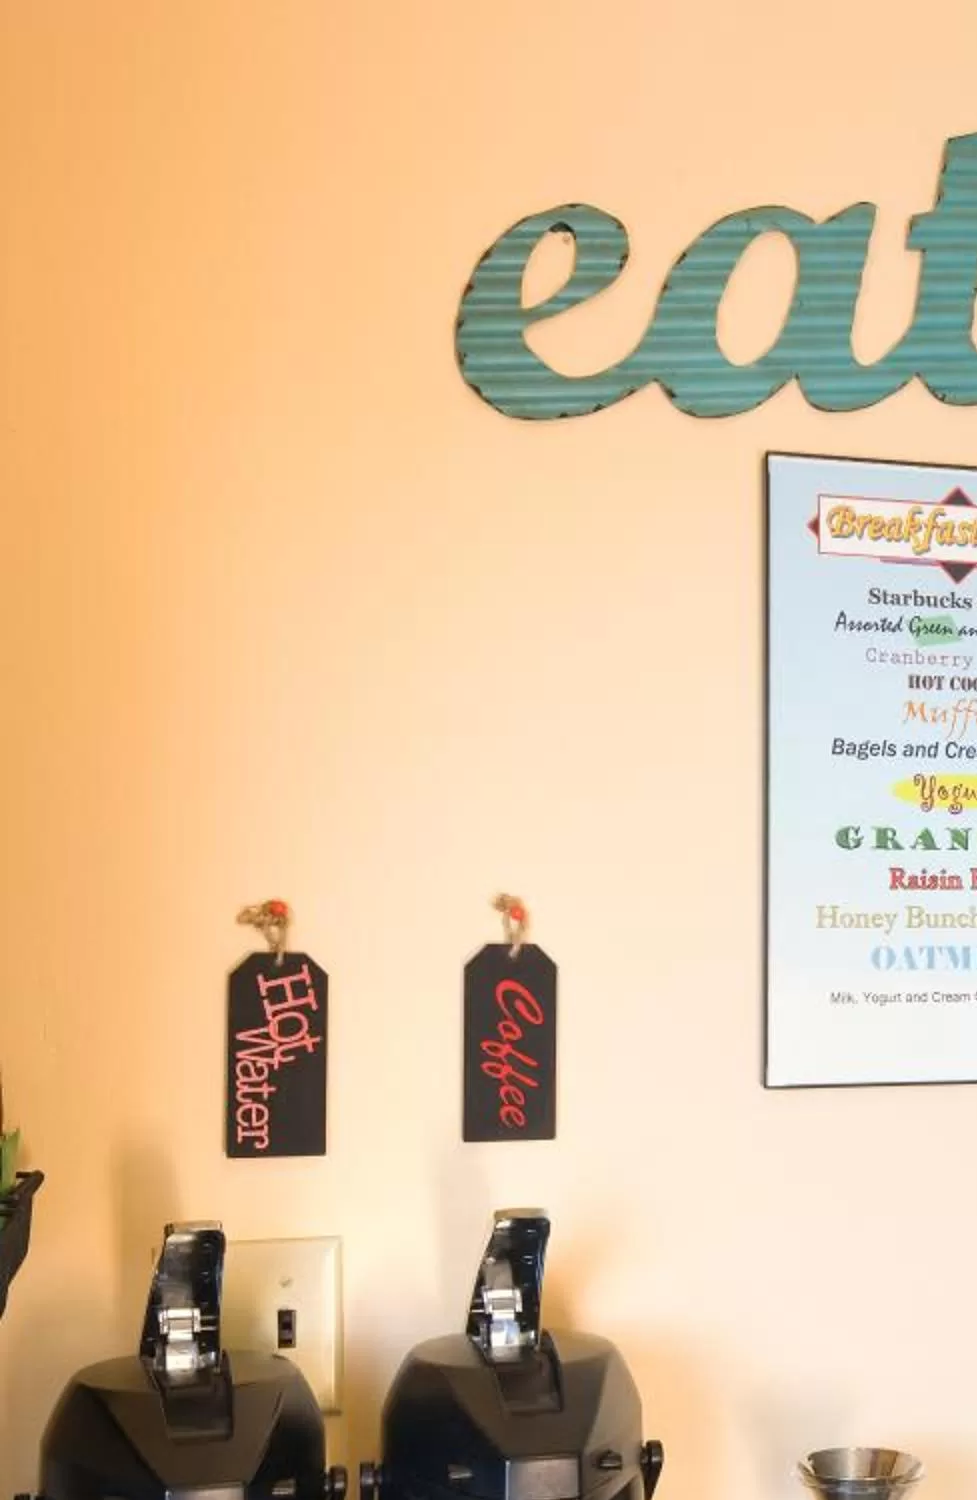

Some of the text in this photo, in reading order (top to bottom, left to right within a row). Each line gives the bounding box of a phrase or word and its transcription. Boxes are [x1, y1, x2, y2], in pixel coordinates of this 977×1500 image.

[868, 588, 973, 611] Starbucks
[834, 611, 902, 634] Assorted
[908, 616, 954, 637] Green
[865, 647, 974, 670] Cranberry
[907, 674, 944, 691] HOT
[831, 737, 897, 759] Bagels
[902, 740, 939, 759] and
[888, 867, 964, 891] Raisin
[815, 905, 898, 935] Honey
[864, 991, 901, 1006] Yogurt
[906, 990, 928, 1003] and
[931, 991, 971, 1003] Cream
[235, 963, 322, 1150] Hot Water
[480, 979, 545, 1129] Coffee
